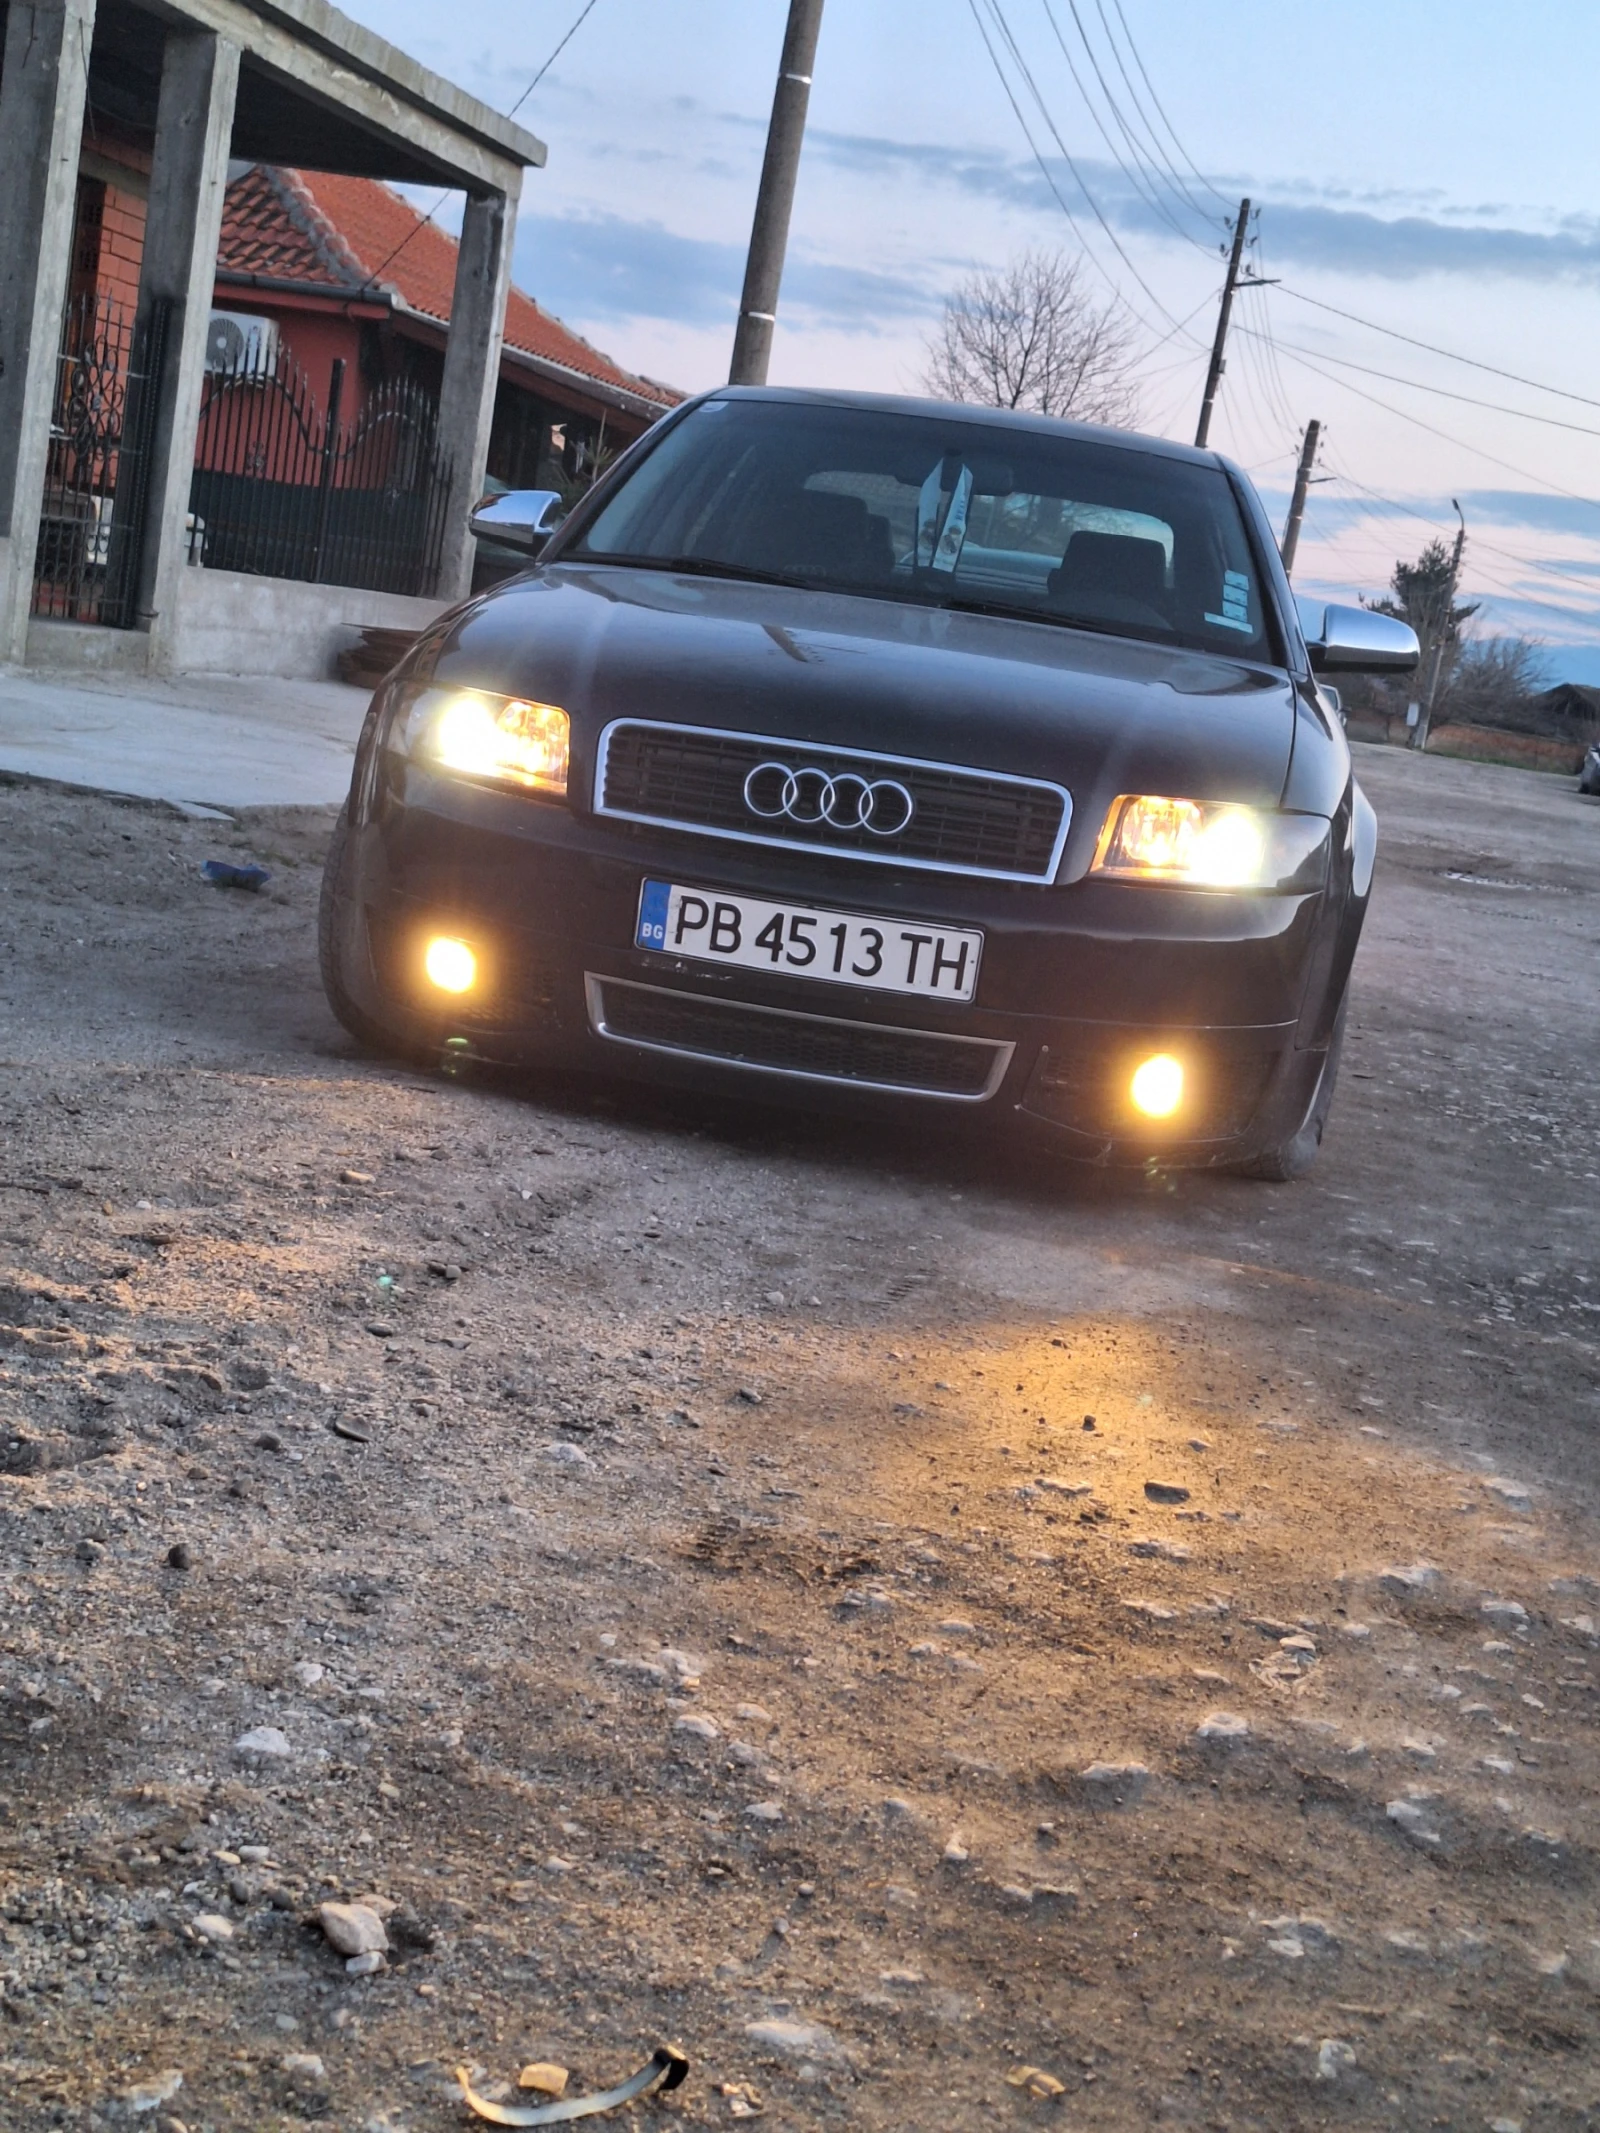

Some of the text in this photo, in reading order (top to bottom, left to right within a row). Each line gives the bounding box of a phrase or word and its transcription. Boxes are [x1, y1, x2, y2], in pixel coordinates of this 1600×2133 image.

[642, 922, 663, 939] BG
[674, 895, 969, 990] PB 4513 TH
